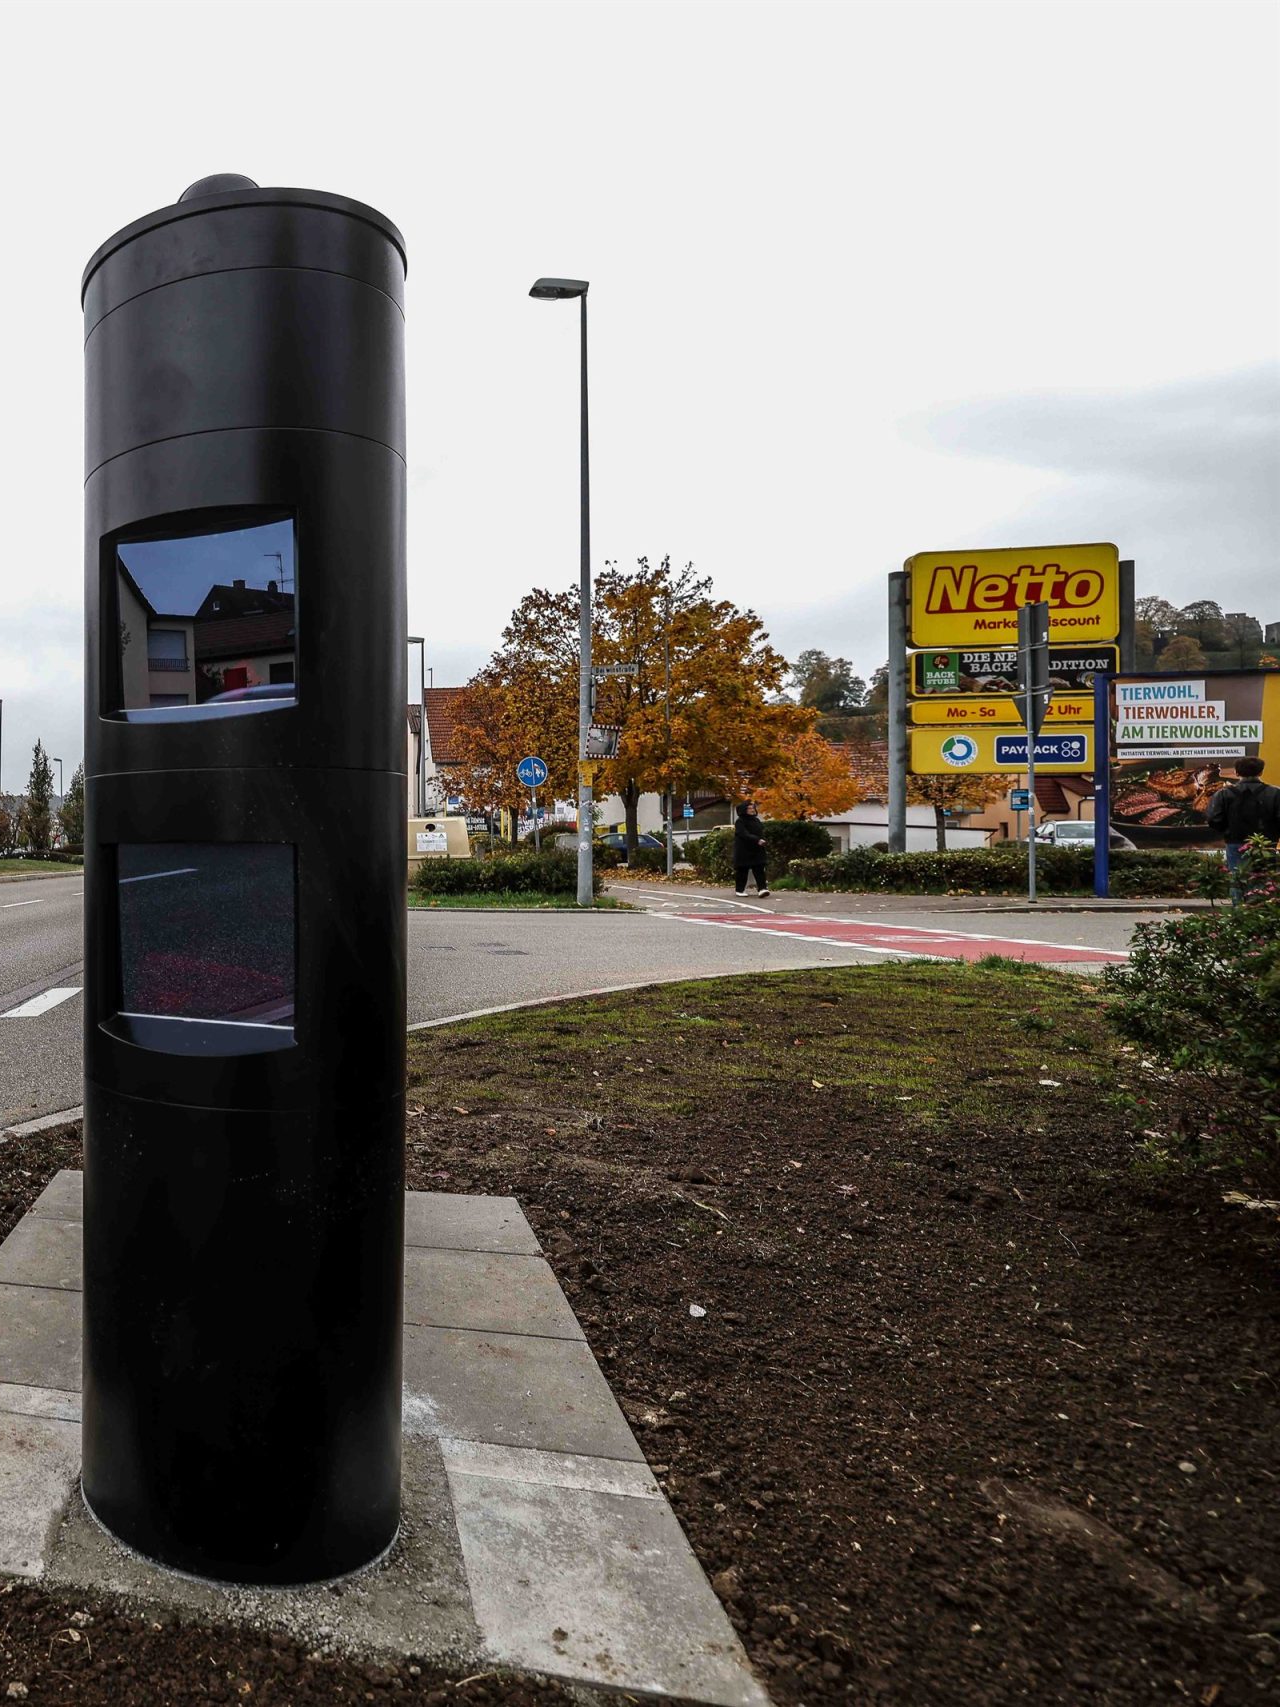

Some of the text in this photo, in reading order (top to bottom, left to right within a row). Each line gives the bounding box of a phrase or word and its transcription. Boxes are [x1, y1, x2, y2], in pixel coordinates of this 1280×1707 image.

[925, 564, 1104, 614] Netto
[974, 615, 1101, 630] Markeiscount
[962, 653, 991, 663] DIE
[926, 671, 955, 679] BACK
[1121, 685, 1199, 700] TIERWOHL,
[946, 707, 967, 717] Mo
[979, 706, 996, 717] Sa
[1057, 705, 1083, 715] Uhr
[1123, 705, 1220, 720] TIERWOHLER,
[1121, 725, 1258, 738] AM TIERWOHLSTEN
